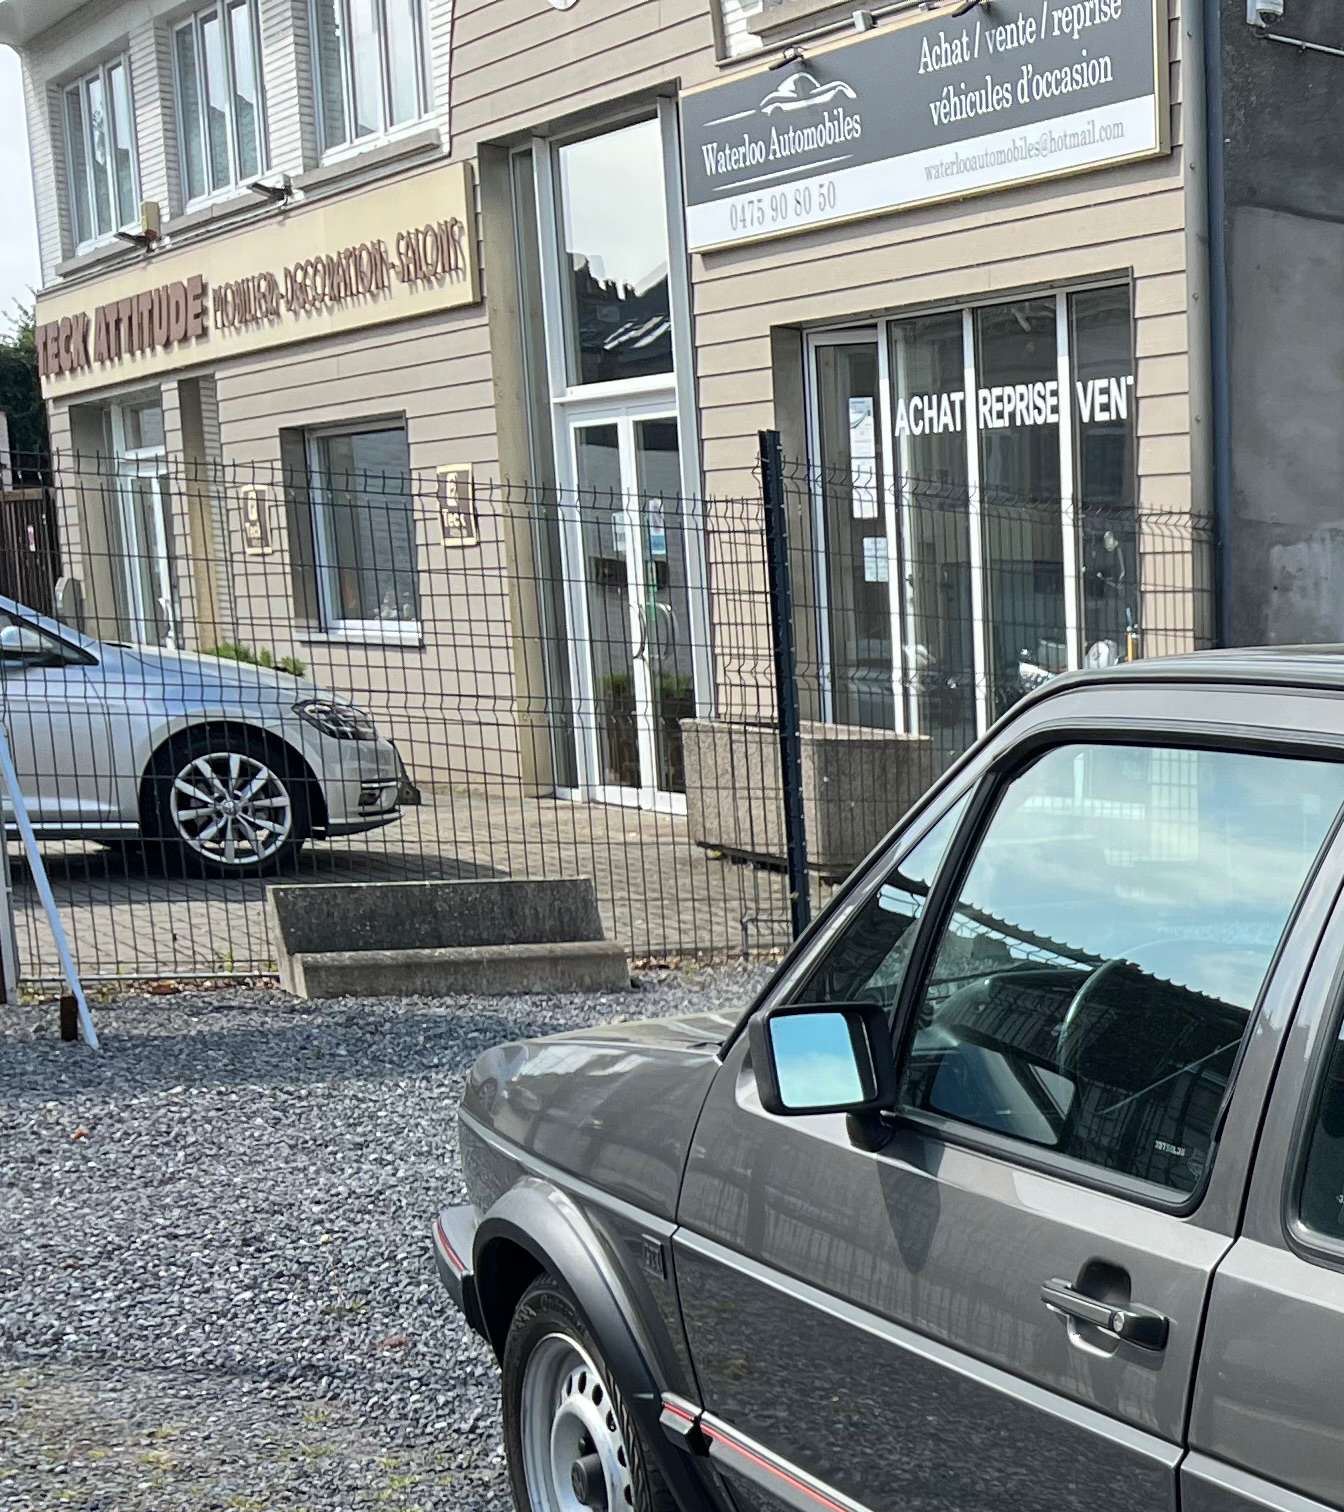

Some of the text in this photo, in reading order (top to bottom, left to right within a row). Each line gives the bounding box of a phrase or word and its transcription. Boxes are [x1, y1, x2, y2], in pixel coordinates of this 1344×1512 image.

[917, 31, 970, 74] Achat
[985, 12, 1037, 54] vente
[1051, 0, 1123, 40] reprise
[929, 75, 1012, 126] véhicules
[702, 107, 862, 176] Waterloo Automobiles
[924, 119, 1125, 182] waterlooautomobiles@hotmail.com
[730, 180, 837, 231] 0475 90 80 50
[37, 311, 90, 377] TECK
[93, 273, 204, 364] ATTITUDE
[894, 391, 965, 437] ACHAT
[977, 380, 1059, 430] REPRISE
[1076, 375, 1135, 424] VEN
